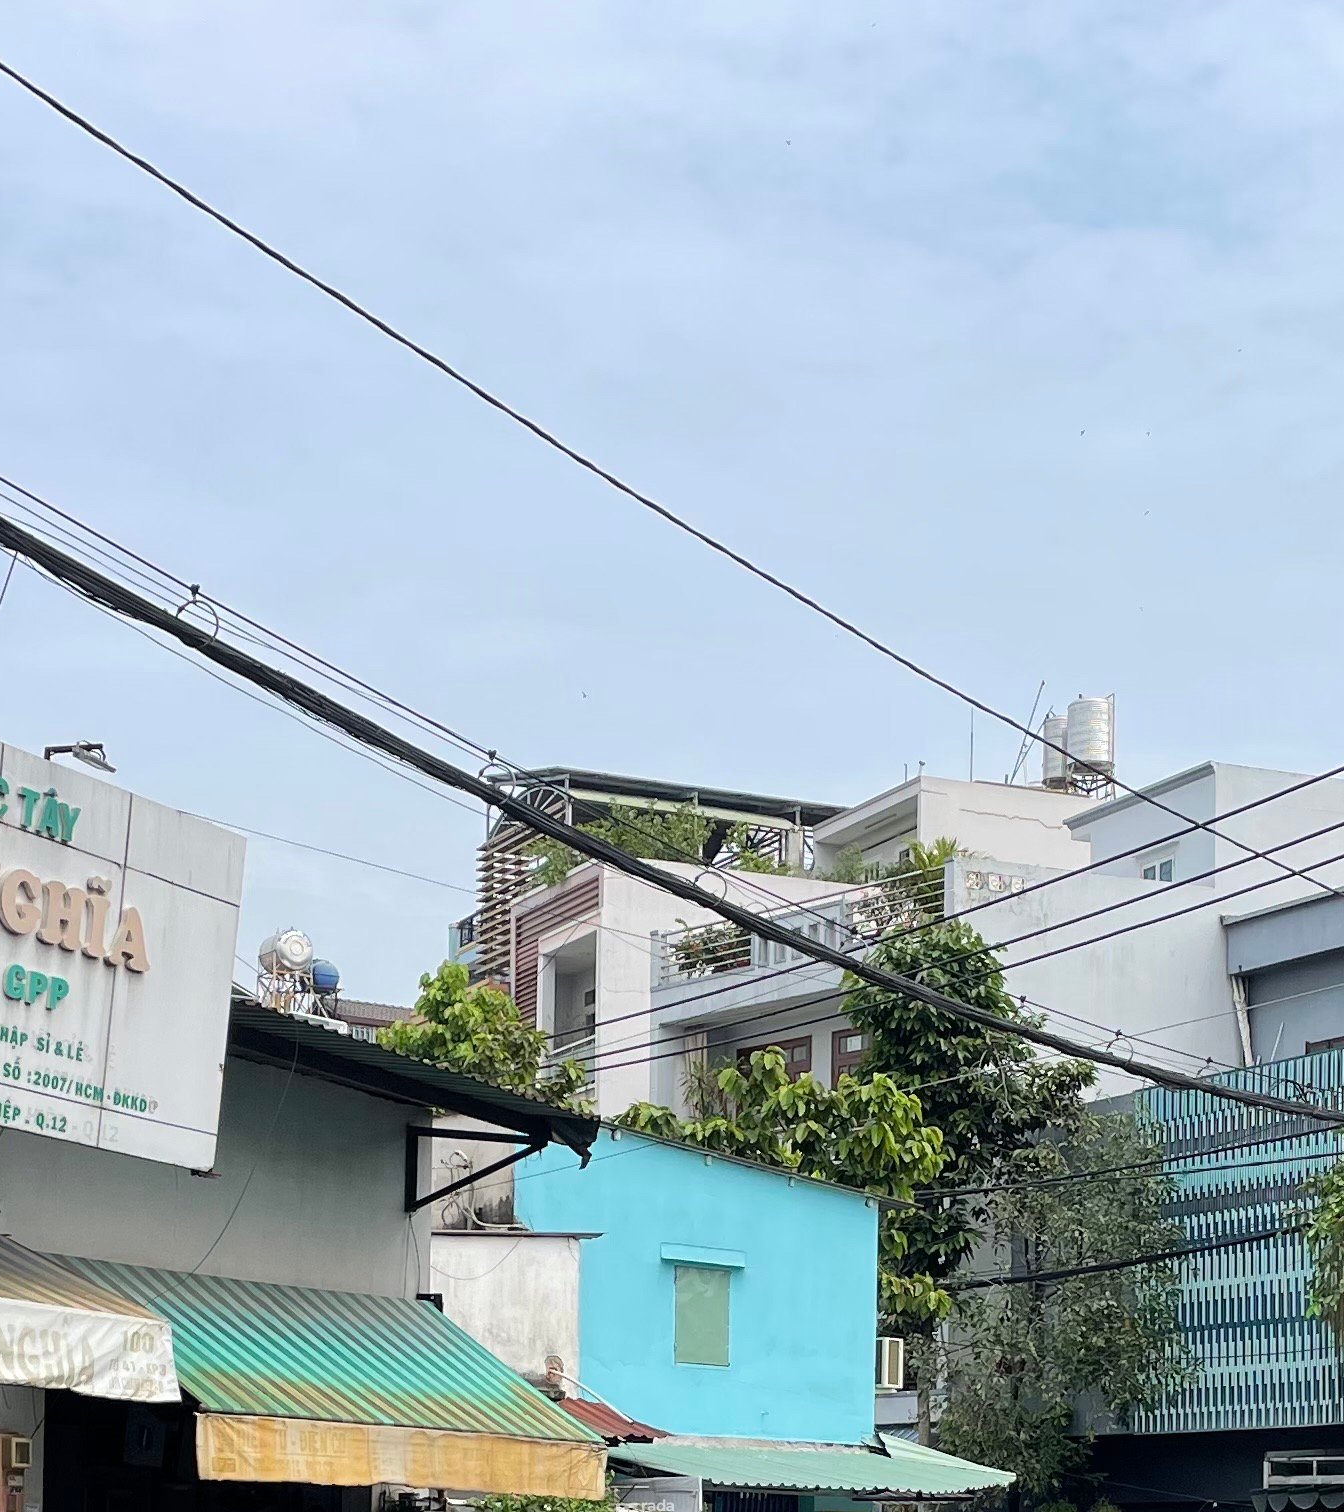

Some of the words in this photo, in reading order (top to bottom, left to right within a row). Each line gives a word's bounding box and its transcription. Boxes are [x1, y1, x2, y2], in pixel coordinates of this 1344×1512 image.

[19, 787, 81, 843] TÂY
[3, 965, 70, 1011] GPP
[2, 1056, 21, 1080] SỐ
[36, 1112, 67, 1132] Q.12
[123, 1330, 154, 1354] 100
